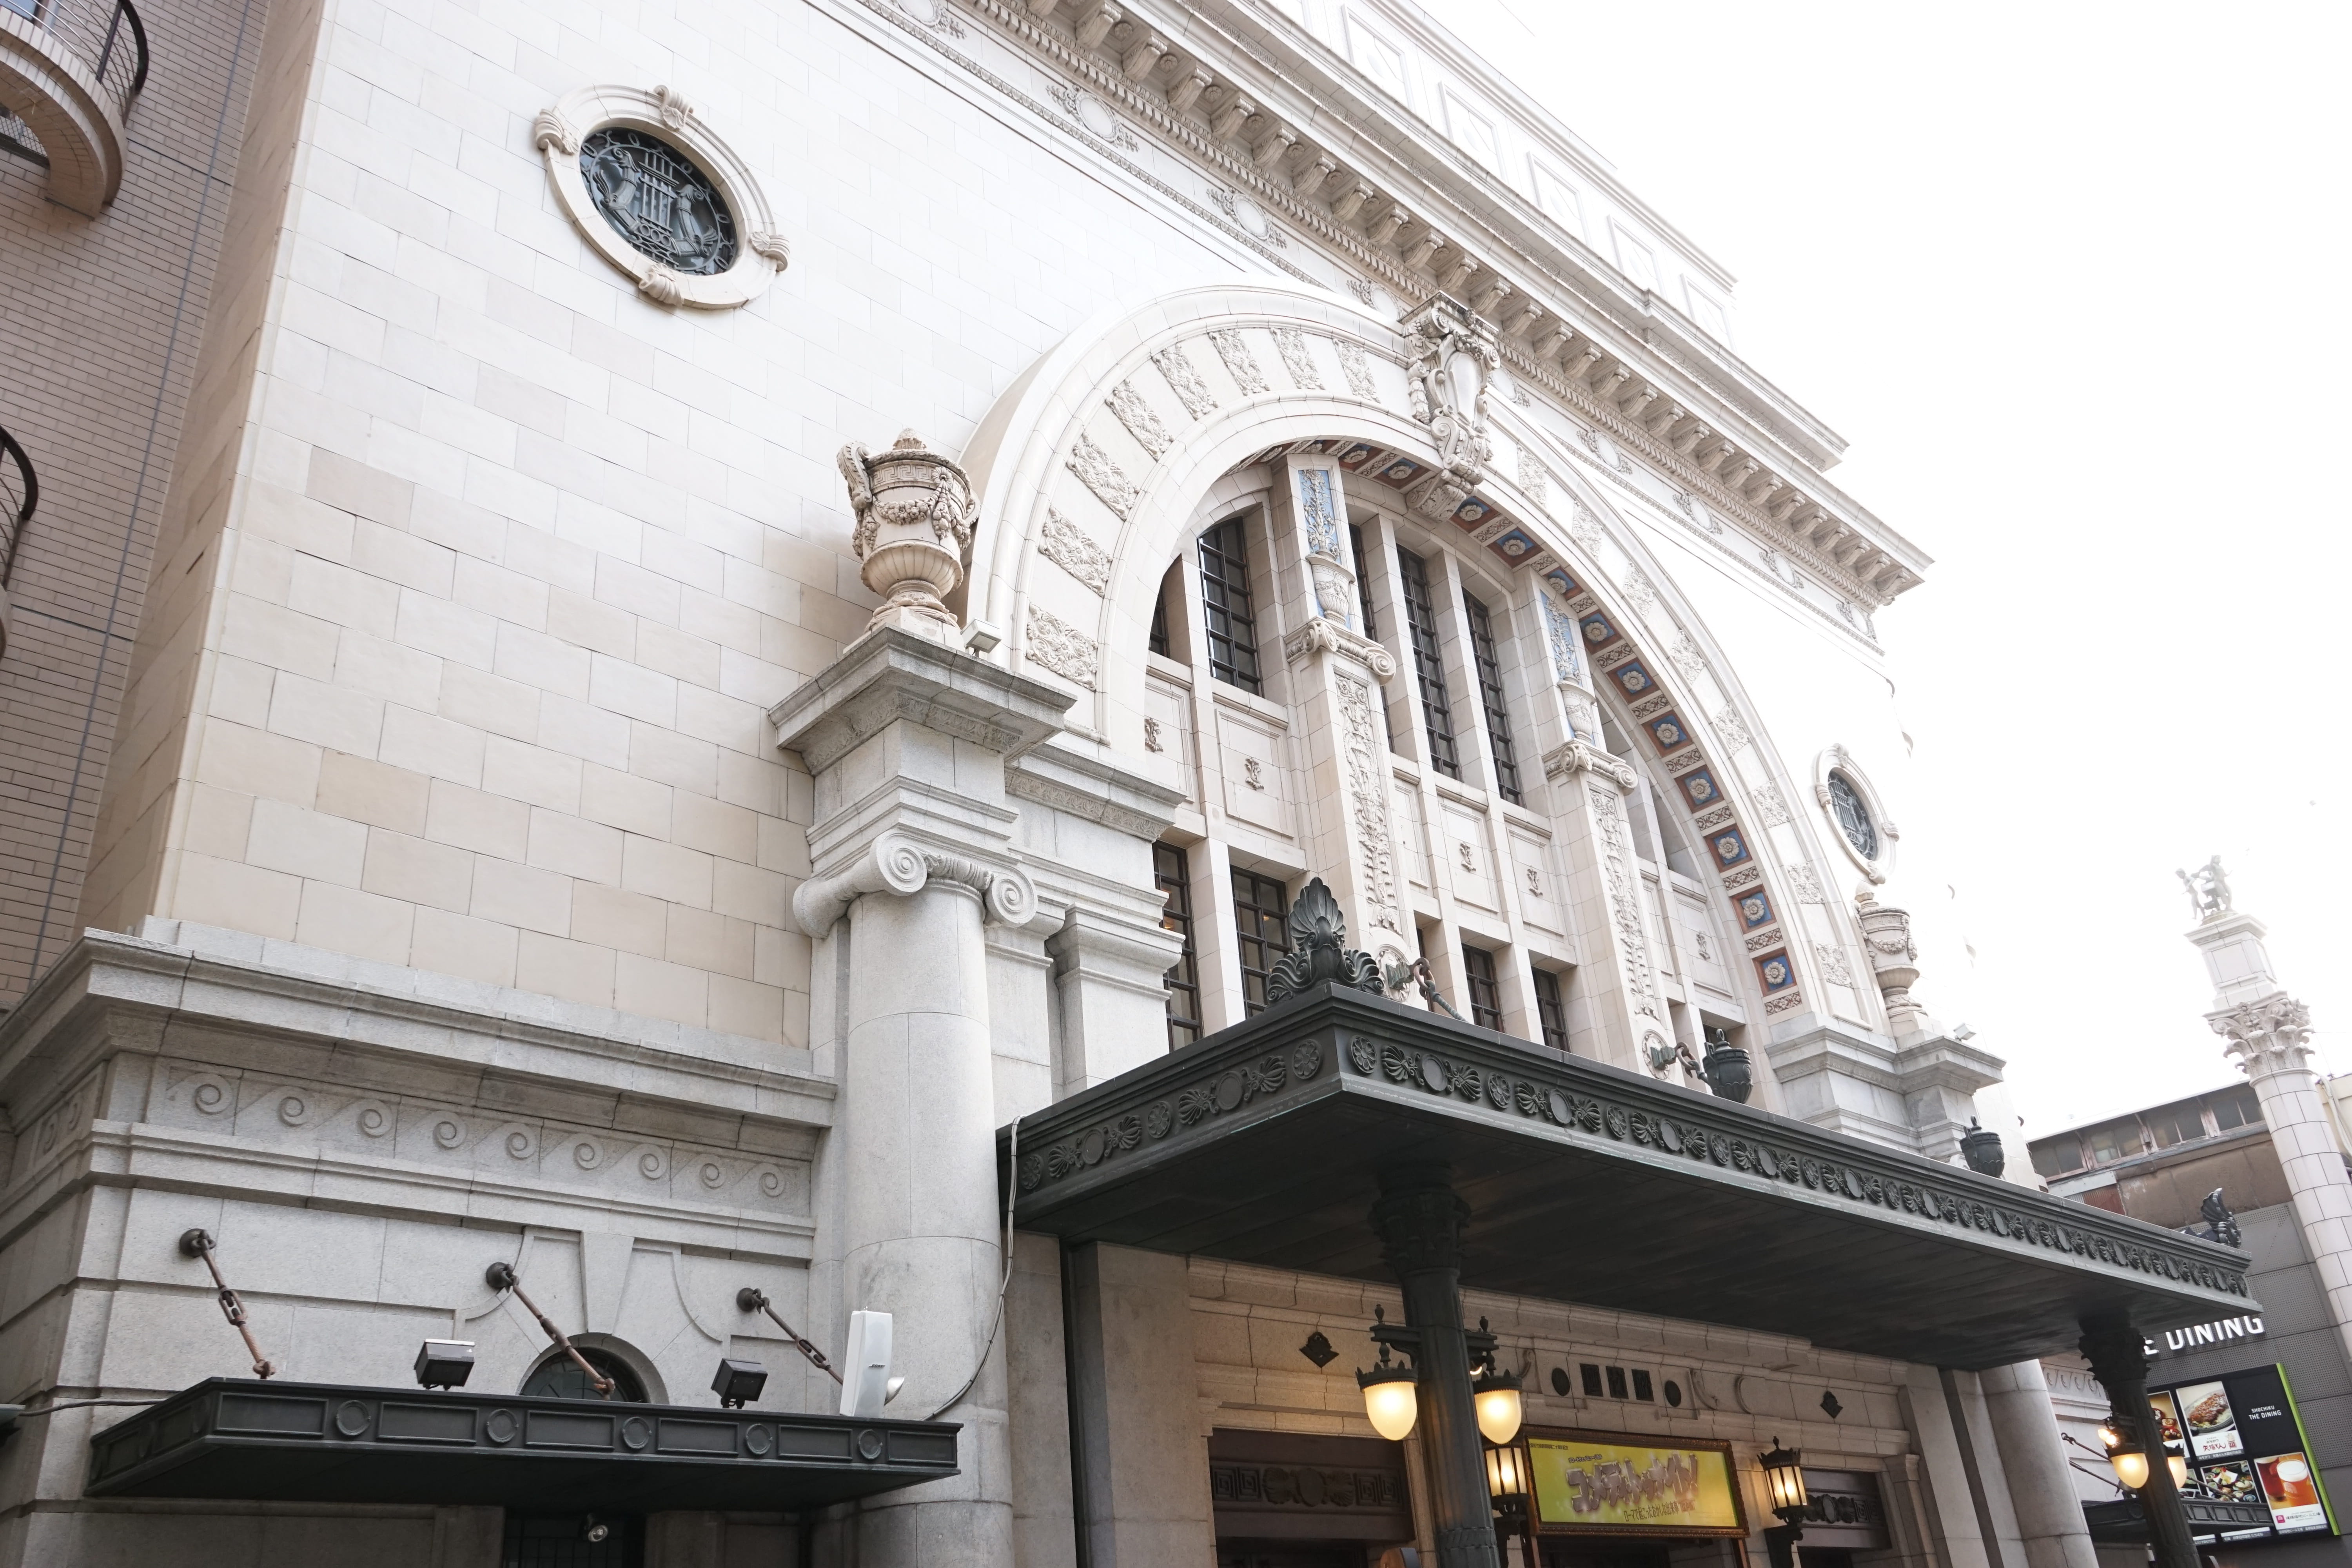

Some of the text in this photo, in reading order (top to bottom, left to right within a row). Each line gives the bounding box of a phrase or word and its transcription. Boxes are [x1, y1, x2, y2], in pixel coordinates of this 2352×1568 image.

[2165, 1316, 2265, 1350] DINING
[2251, 1405, 2275, 1413] SHOCHIKU
[2261, 1410, 2281, 1418] DINING
